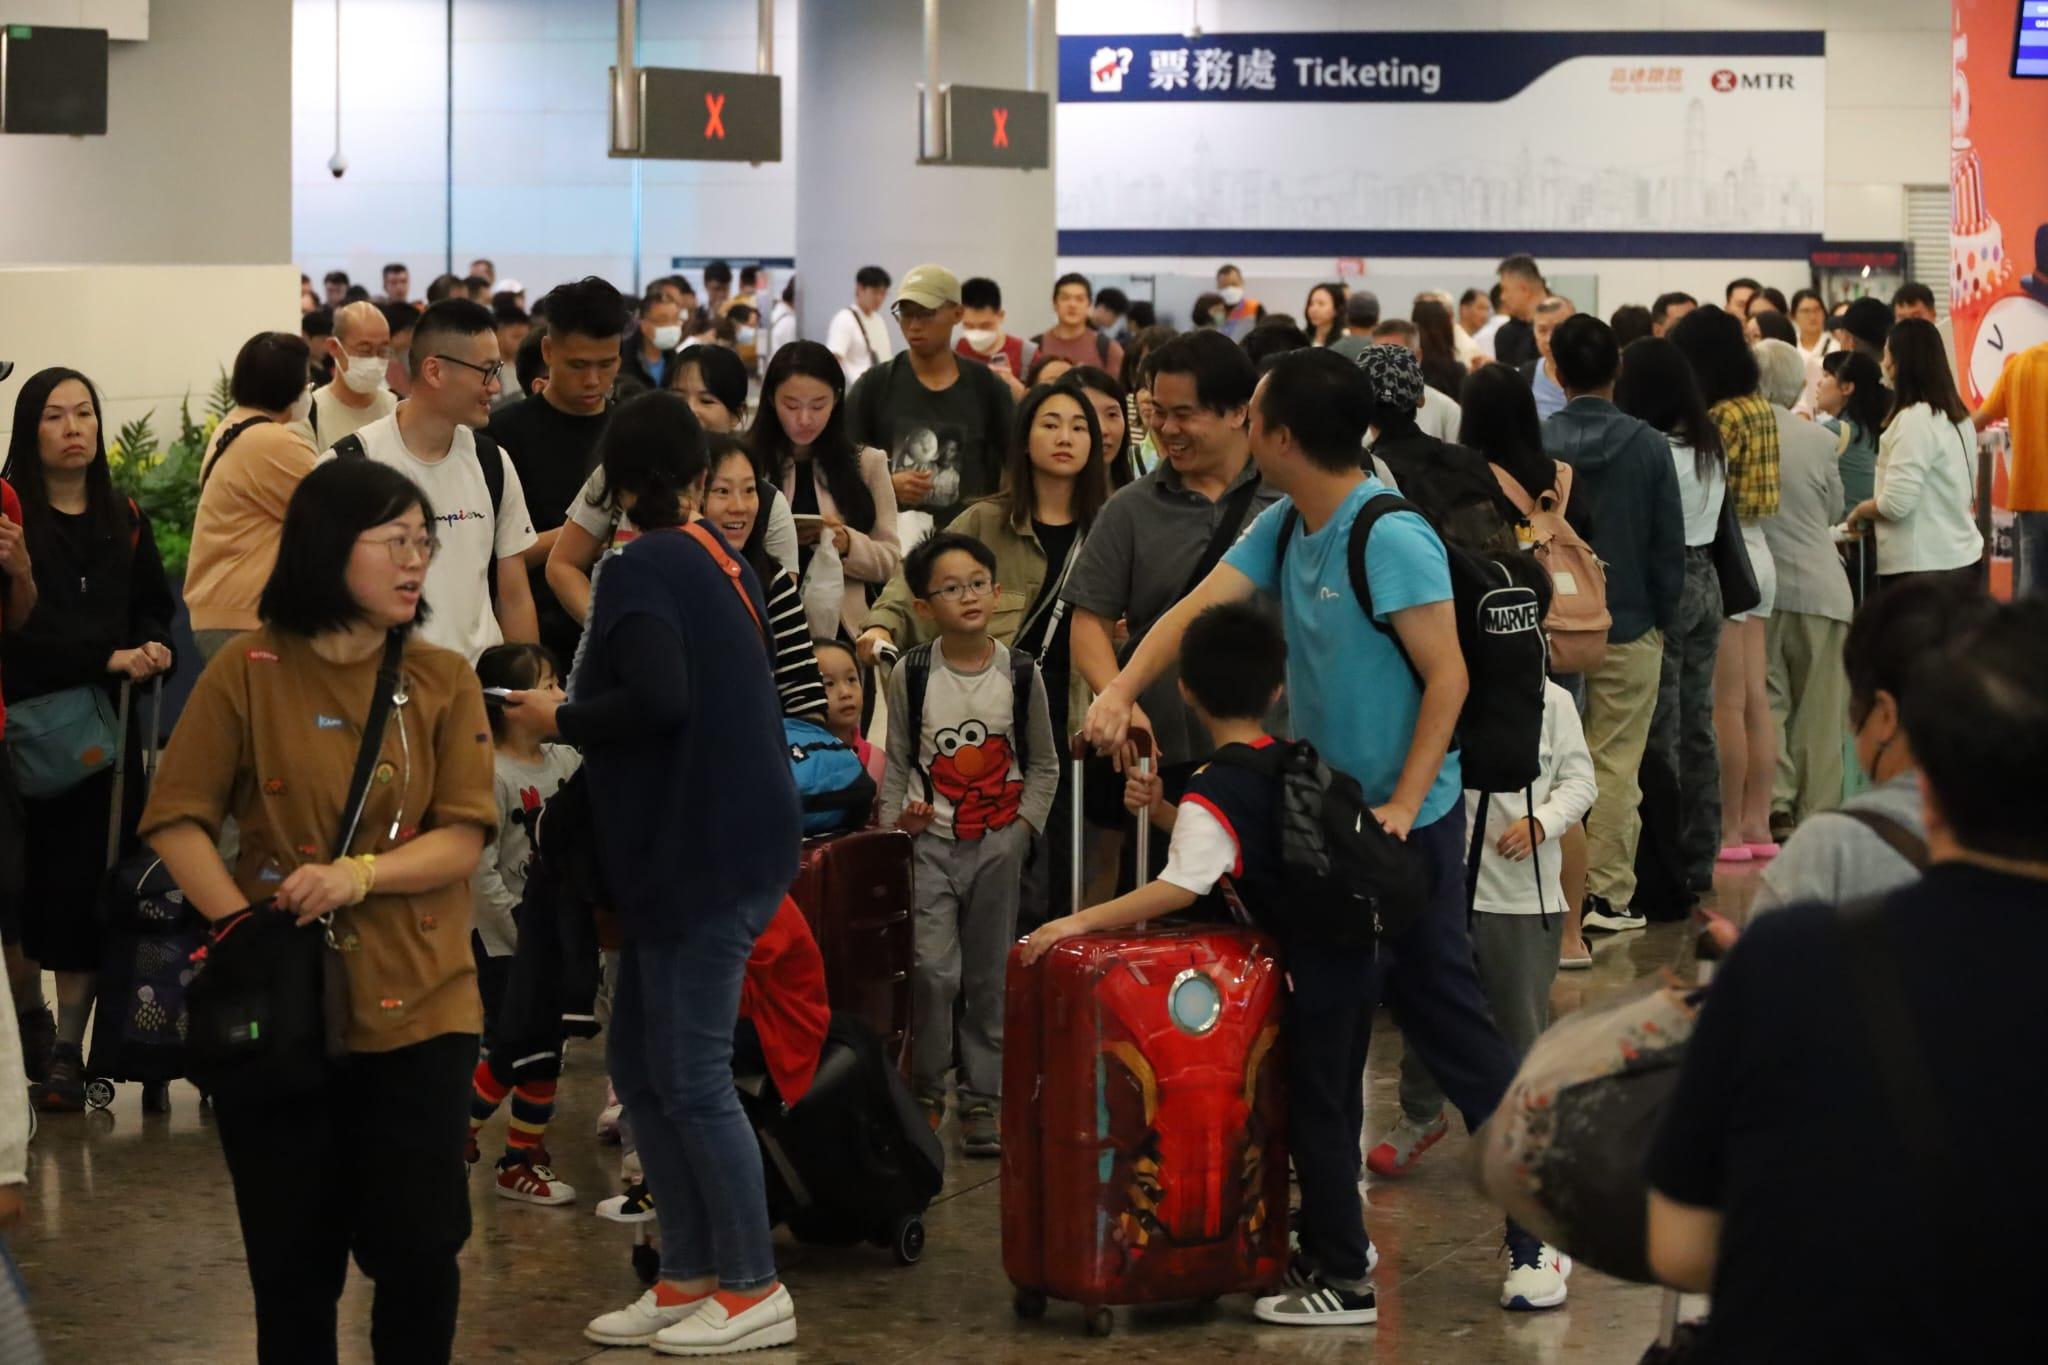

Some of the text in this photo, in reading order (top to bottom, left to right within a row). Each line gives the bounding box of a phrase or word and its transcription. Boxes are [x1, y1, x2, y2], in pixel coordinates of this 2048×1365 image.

[1149, 48, 1441, 94] 票務處 Ticketing
[1741, 73, 1795, 90] MTR
[434, 509, 485, 528] mpion
